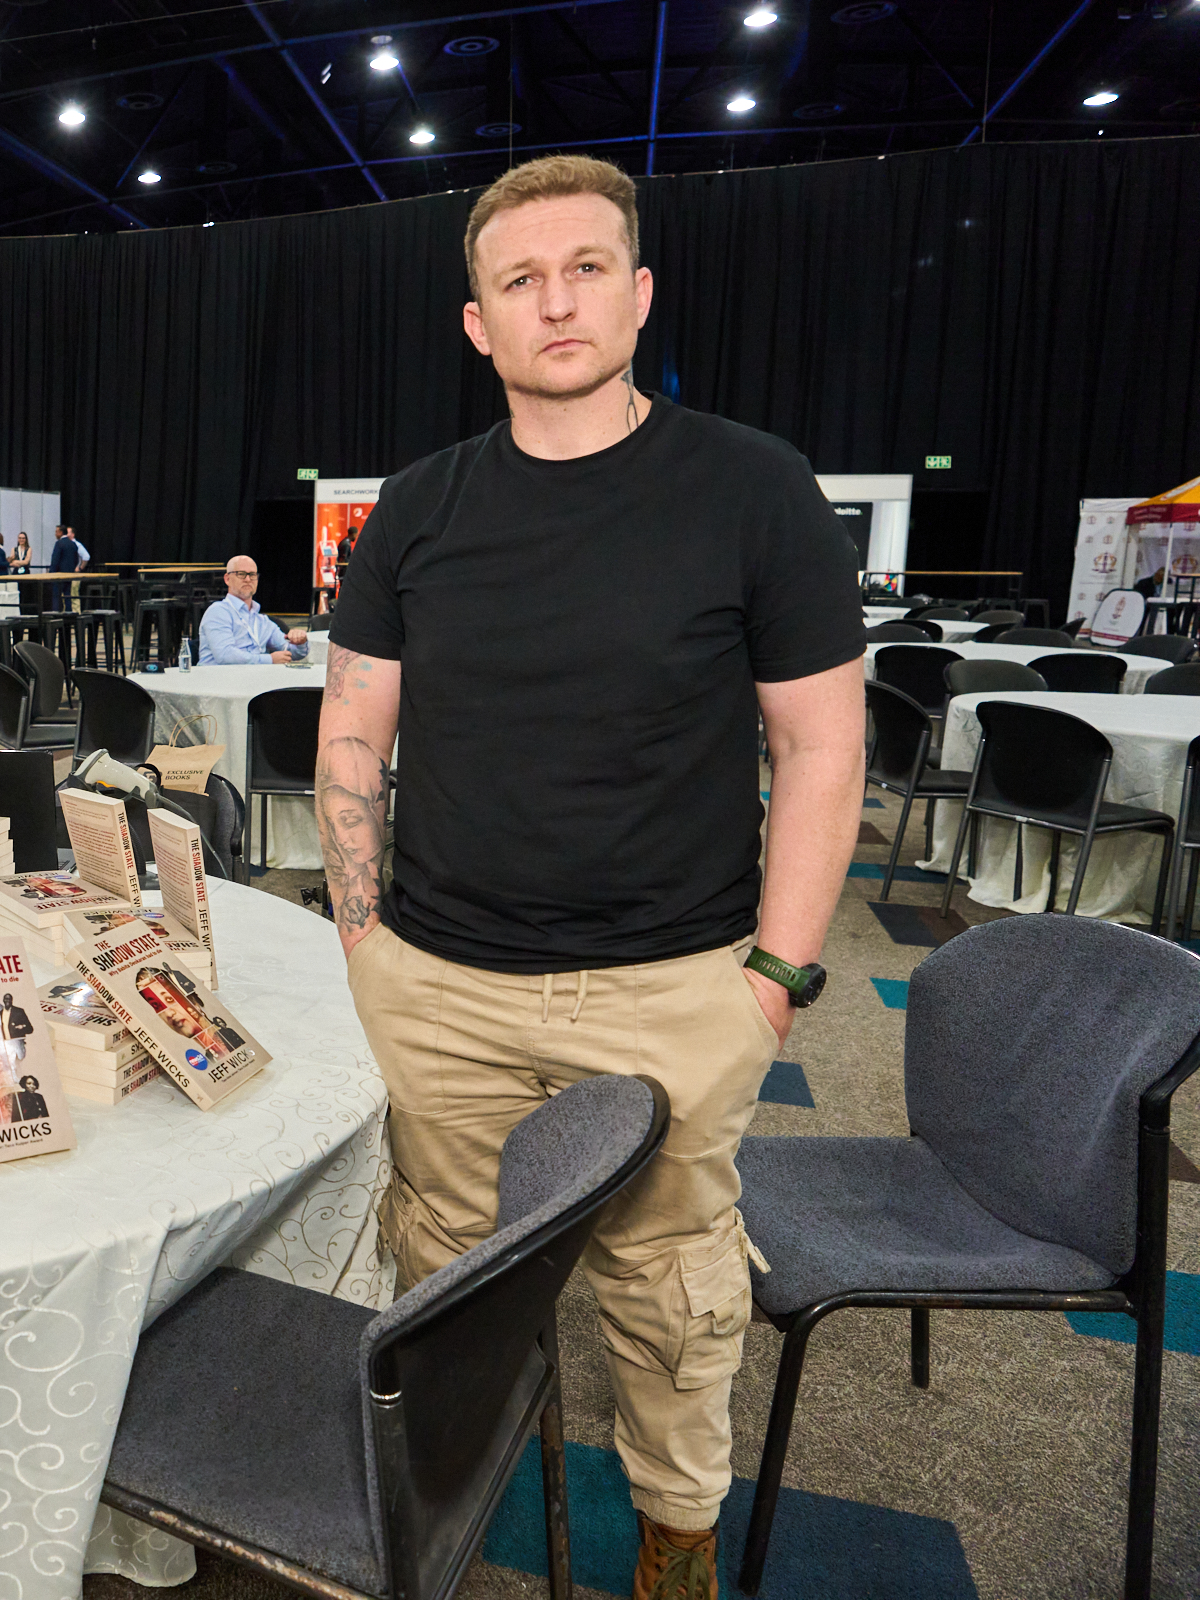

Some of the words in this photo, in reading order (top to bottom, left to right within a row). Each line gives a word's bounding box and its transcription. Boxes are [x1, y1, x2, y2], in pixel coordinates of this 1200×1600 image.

[120, 824, 130, 850] SHADOW
[191, 839, 199, 854] THE
[125, 849, 134, 869] STATE
[192, 854, 204, 881] SHADOW
[129, 874, 139, 897] JEFF
[196, 881, 206, 902] STATE
[199, 909, 209, 931] JEFF
[93, 945, 131, 972] SHADOW
[131, 933, 160, 952] STATE
[94, 939, 111, 952] THE
[9, 975, 19, 983] die
[76, 960, 89, 976] THE
[87, 973, 115, 1003] SHADOW
[111, 1000, 133, 1024] STATE
[134, 1027, 158, 1051] JEFF
[157, 1051, 190, 1088] WICKS
[123, 1070, 132, 1080] THE
[208, 1063, 231, 1083] JEFF
[121, 1087, 130, 1098] THE
[130, 1074, 148, 1092] SHADOW
